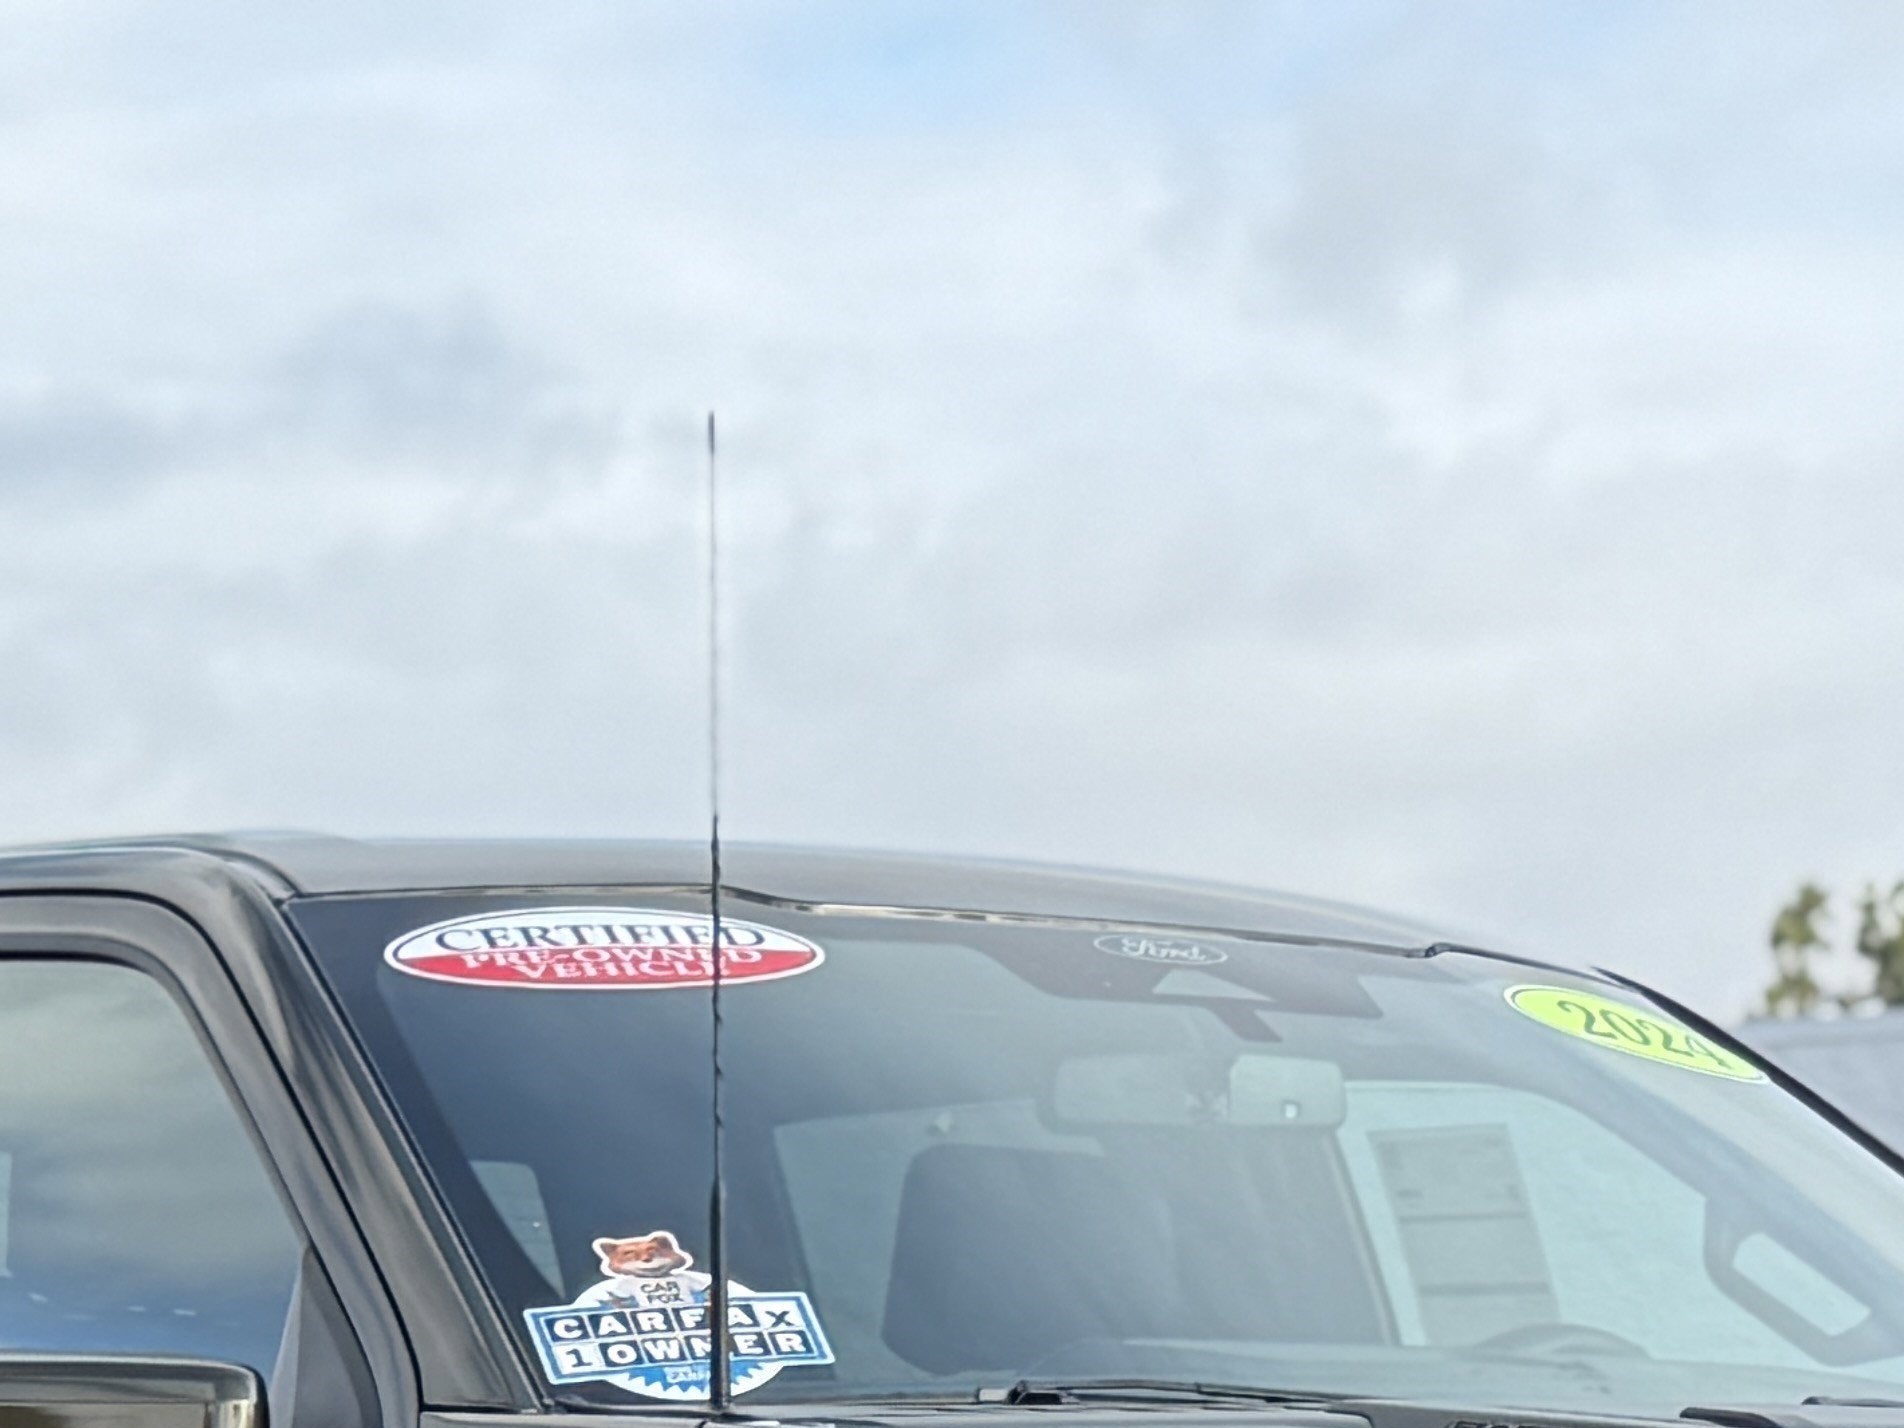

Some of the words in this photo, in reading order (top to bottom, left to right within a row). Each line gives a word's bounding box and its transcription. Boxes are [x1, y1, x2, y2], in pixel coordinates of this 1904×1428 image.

[435, 924, 765, 951] CERTIFIED
[460, 948, 762, 968] PRE-OWNED
[511, 959, 731, 979] VEHICLE
[1557, 1000, 1732, 1069] 2024
[552, 1304, 796, 1340] CARFAX
